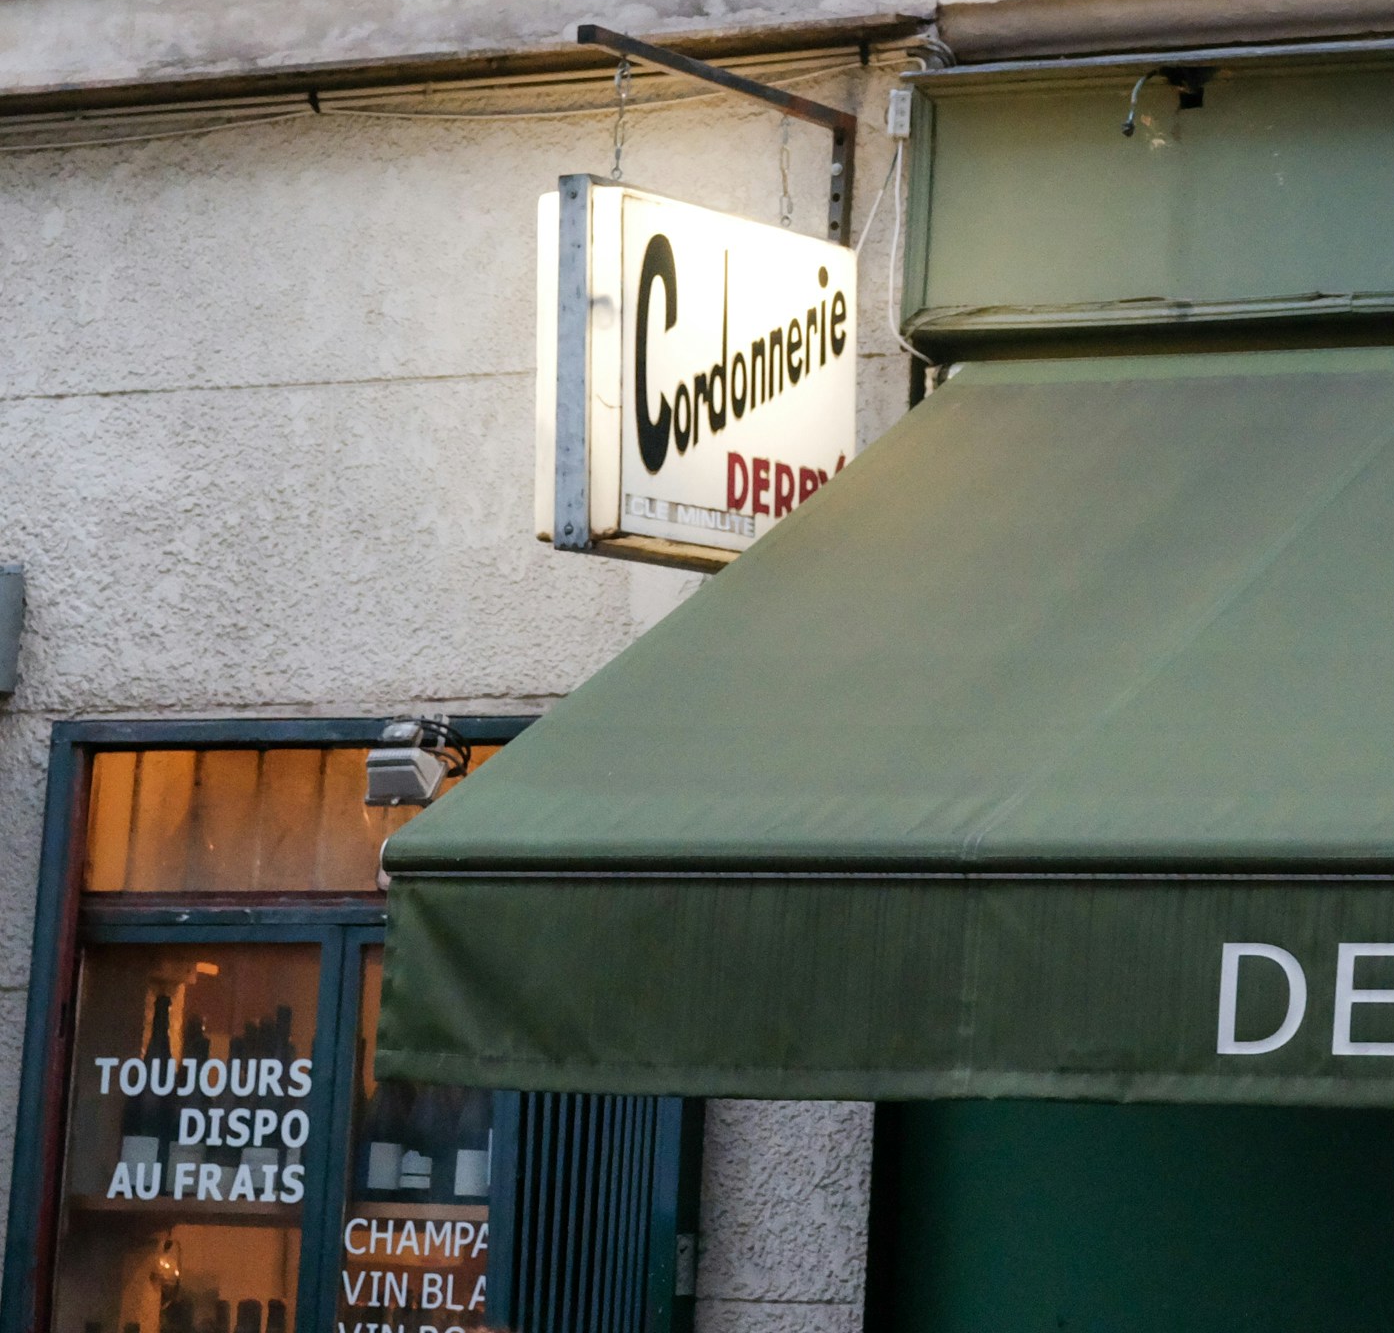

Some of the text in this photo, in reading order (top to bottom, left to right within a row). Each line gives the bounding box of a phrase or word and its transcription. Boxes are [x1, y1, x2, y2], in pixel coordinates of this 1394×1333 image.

[635, 233, 848, 475] Cordonnerie
[677, 503, 756, 539] MINUTE
[94, 1057, 313, 1098] TOUJOURS
[178, 1107, 310, 1149] DISPO
[106, 1161, 306, 1204] AU FRAIS
[341, 1269, 409, 1309] VIN
